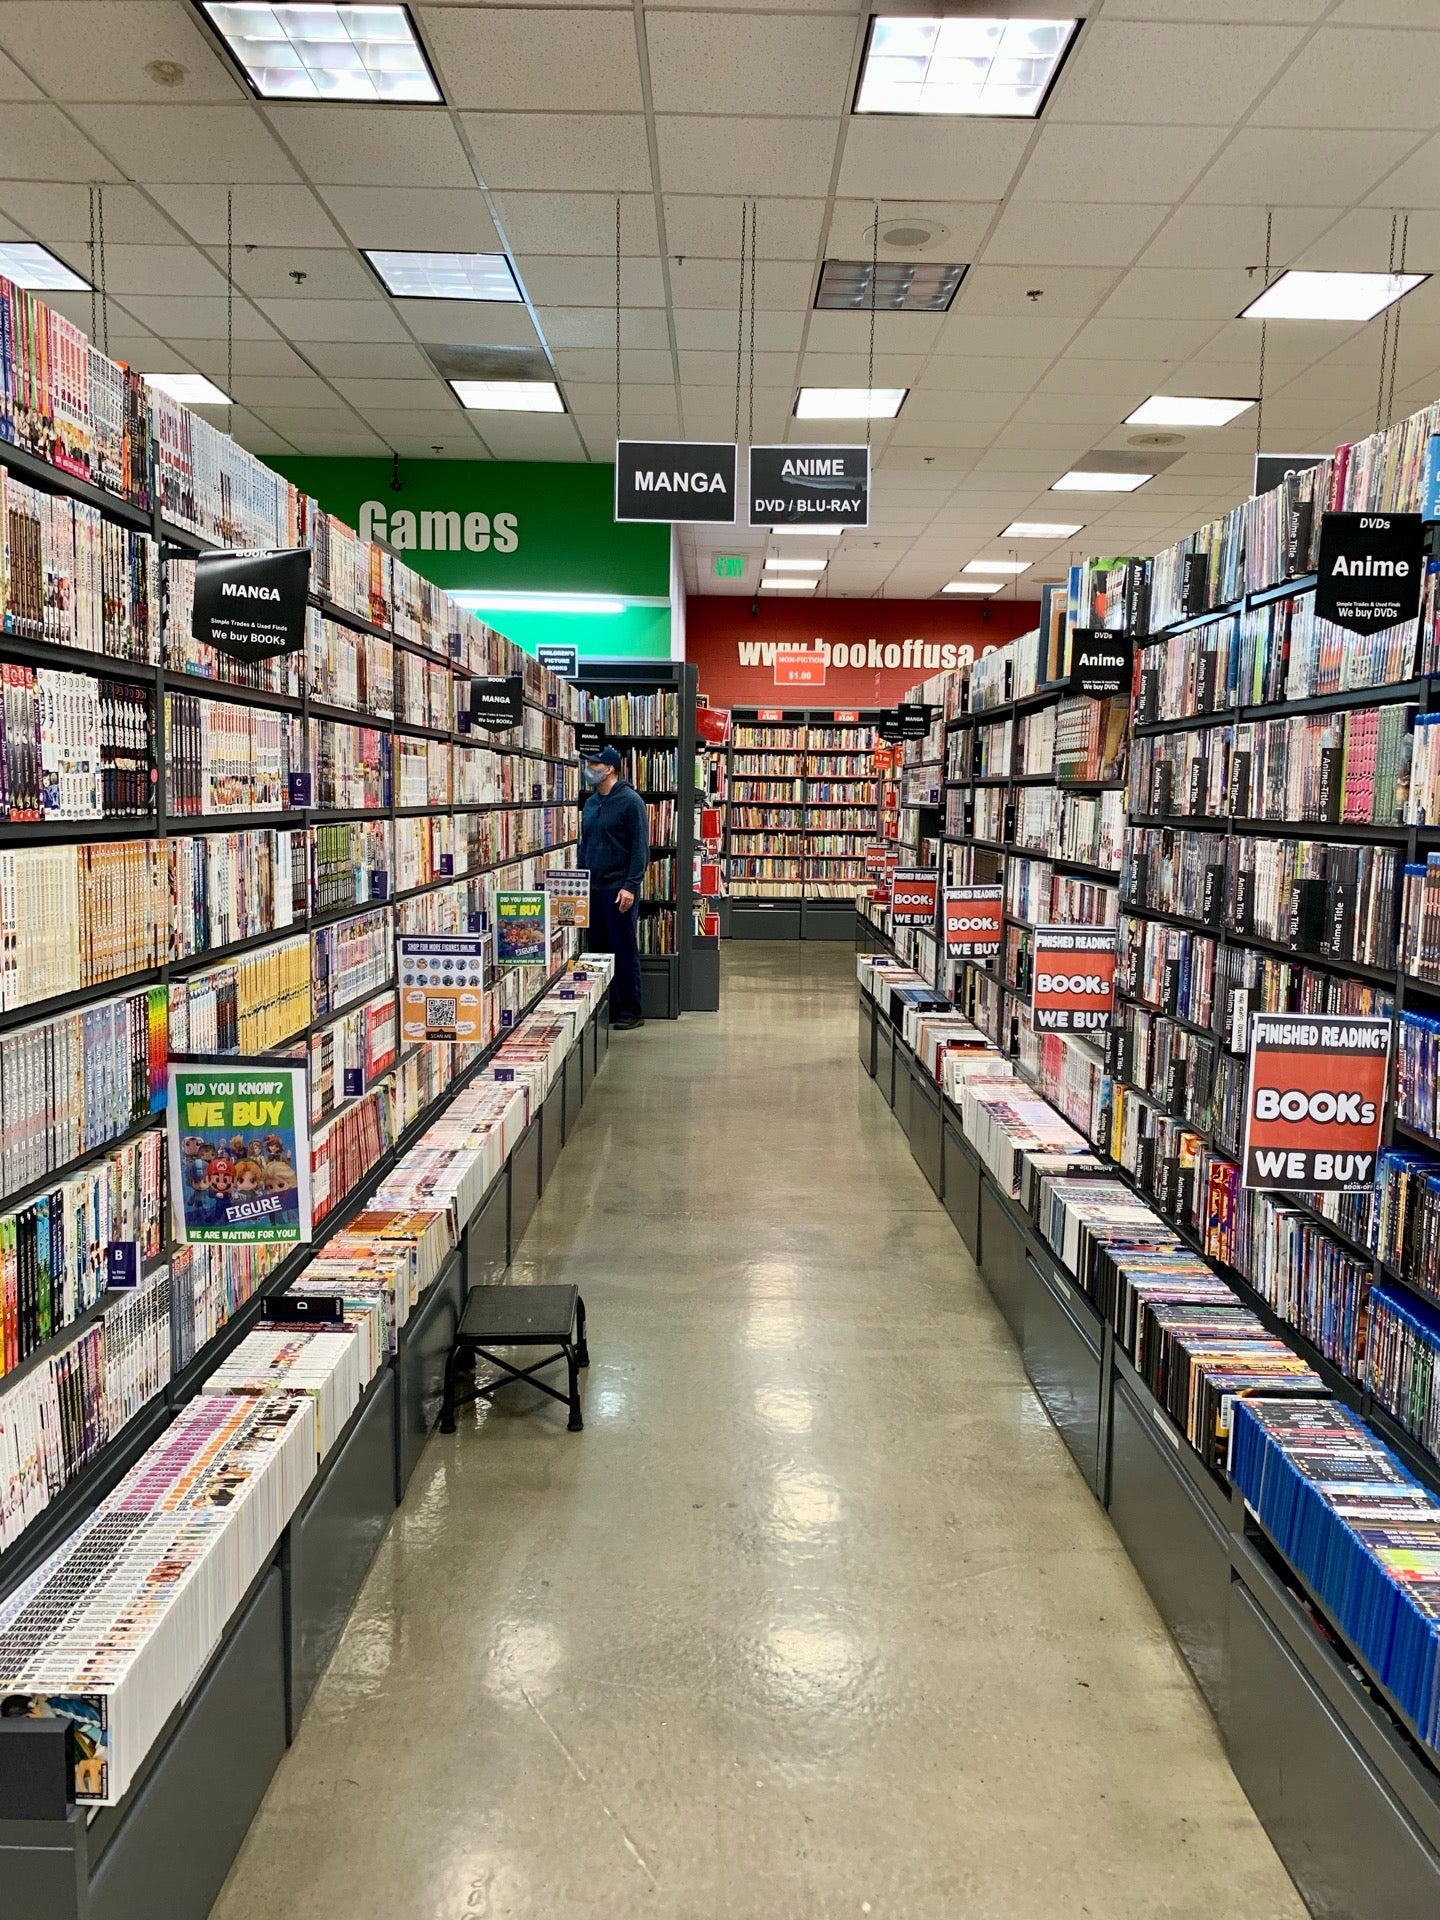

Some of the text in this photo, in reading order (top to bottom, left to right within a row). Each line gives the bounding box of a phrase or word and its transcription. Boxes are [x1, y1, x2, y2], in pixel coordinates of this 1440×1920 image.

[781, 459, 844, 476] ANIME
[634, 471, 726, 493] MANGA
[755, 500, 785, 512] DVD
[797, 500, 861, 512] BLU-RAY
[359, 500, 519, 553] Games
[1291, 512, 1299, 539] Anime
[1359, 518, 1391, 530] DVDs
[1331, 555, 1410, 577] Anime
[222, 583, 280, 601] MANGA
[1338, 607, 1398, 619] We buy DVDs
[210, 618, 230, 626] Simple
[231, 620, 250, 628] Trades
[212, 629, 286, 646] We buy BOOKs
[779, 656, 825, 665] NON-FICTION
[1079, 653, 1125, 667] Anime
[789, 672, 812, 681] $1.00
[1093, 683, 1103, 691] buy
[482, 695, 511, 704] MANGA
[1191, 764, 1200, 787] Anime
[1231, 758, 1241, 781] Anime
[894, 894, 933, 906] BOOKs
[946, 889, 1002, 900] FINISHED READING?
[500, 904, 541, 916] WE BUY
[1291, 888, 1300, 935] Anime Title
[894, 914, 933, 924] WE BUY
[947, 918, 999, 931] BOOKs
[1332, 902, 1344, 952] Anime Title
[949, 943, 1000, 955] WE BUY
[1036, 935, 1115, 950] FINISHED READING?
[514, 945, 539, 956] FIGURE
[1037, 974, 1110, 994] BOOKs
[1163, 966, 1172, 989] Anime
[1038, 1010, 1109, 1029] WE BUY
[1226, 1011, 1234, 1030] Title
[1257, 1023, 1388, 1049] FINISHED READING?
[186, 1082, 283, 1096] DID YOU KNOW?
[186, 1101, 284, 1127] WE BUY
[1255, 1089, 1375, 1124] BOOKs
[1255, 1150, 1372, 1181] WE BUY
[225, 1196, 282, 1221] FIGURE
[190, 1229, 296, 1240] WE ARE WAITING FOR YOU!
[115, 1250, 122, 1261] B
[297, 1302, 308, 1310] D
